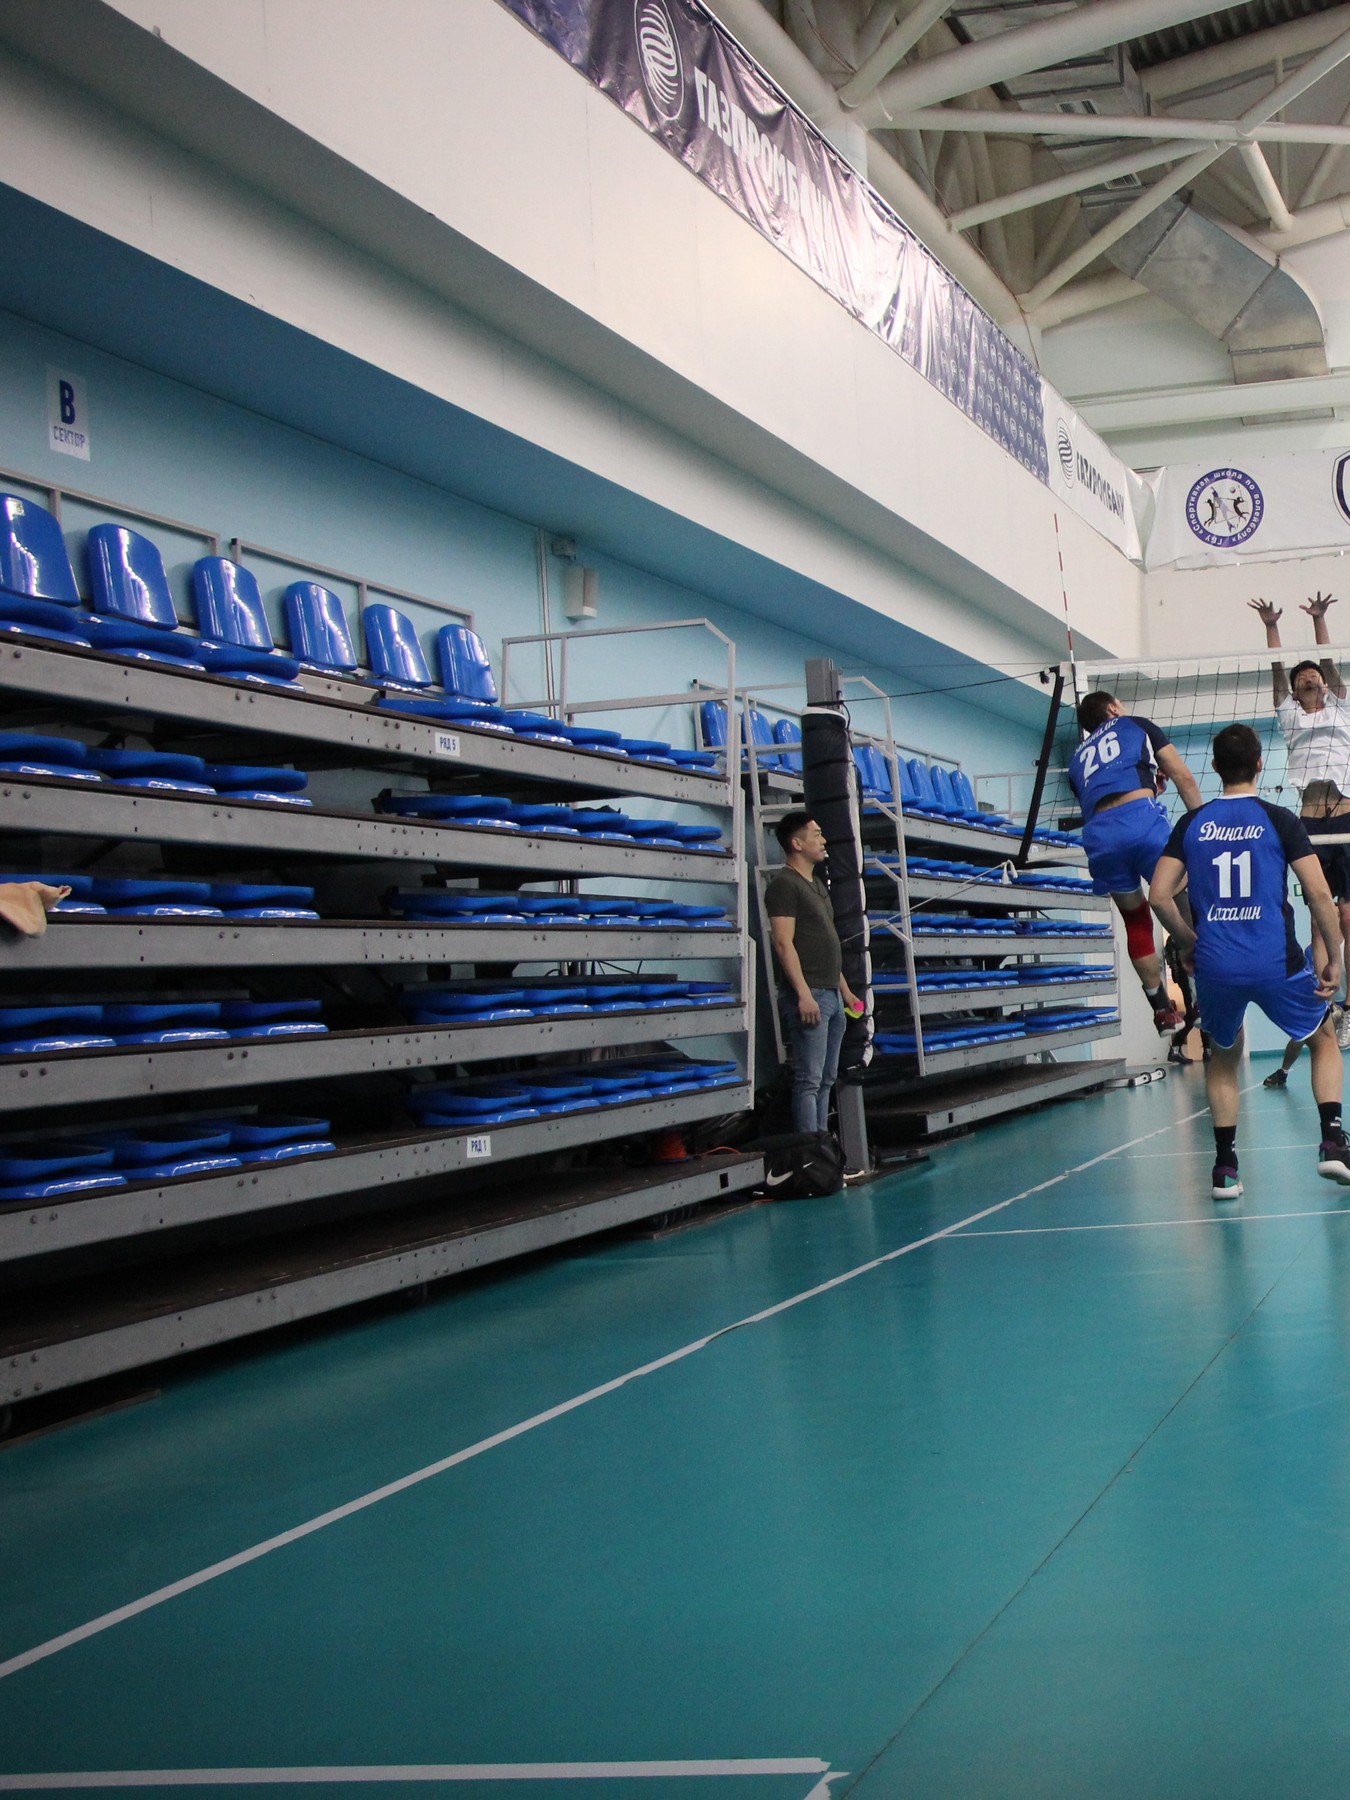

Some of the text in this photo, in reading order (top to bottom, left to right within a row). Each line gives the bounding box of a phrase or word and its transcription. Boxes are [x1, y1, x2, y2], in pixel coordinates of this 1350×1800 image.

[59, 379, 76, 425] В
[53, 425, 86, 449] СЕКТОР
[1205, 534, 1223, 546] ГБУ
[1079, 731, 1121, 780] 26
[1198, 820, 1265, 842] Динамо
[1211, 850, 1251, 898] 11
